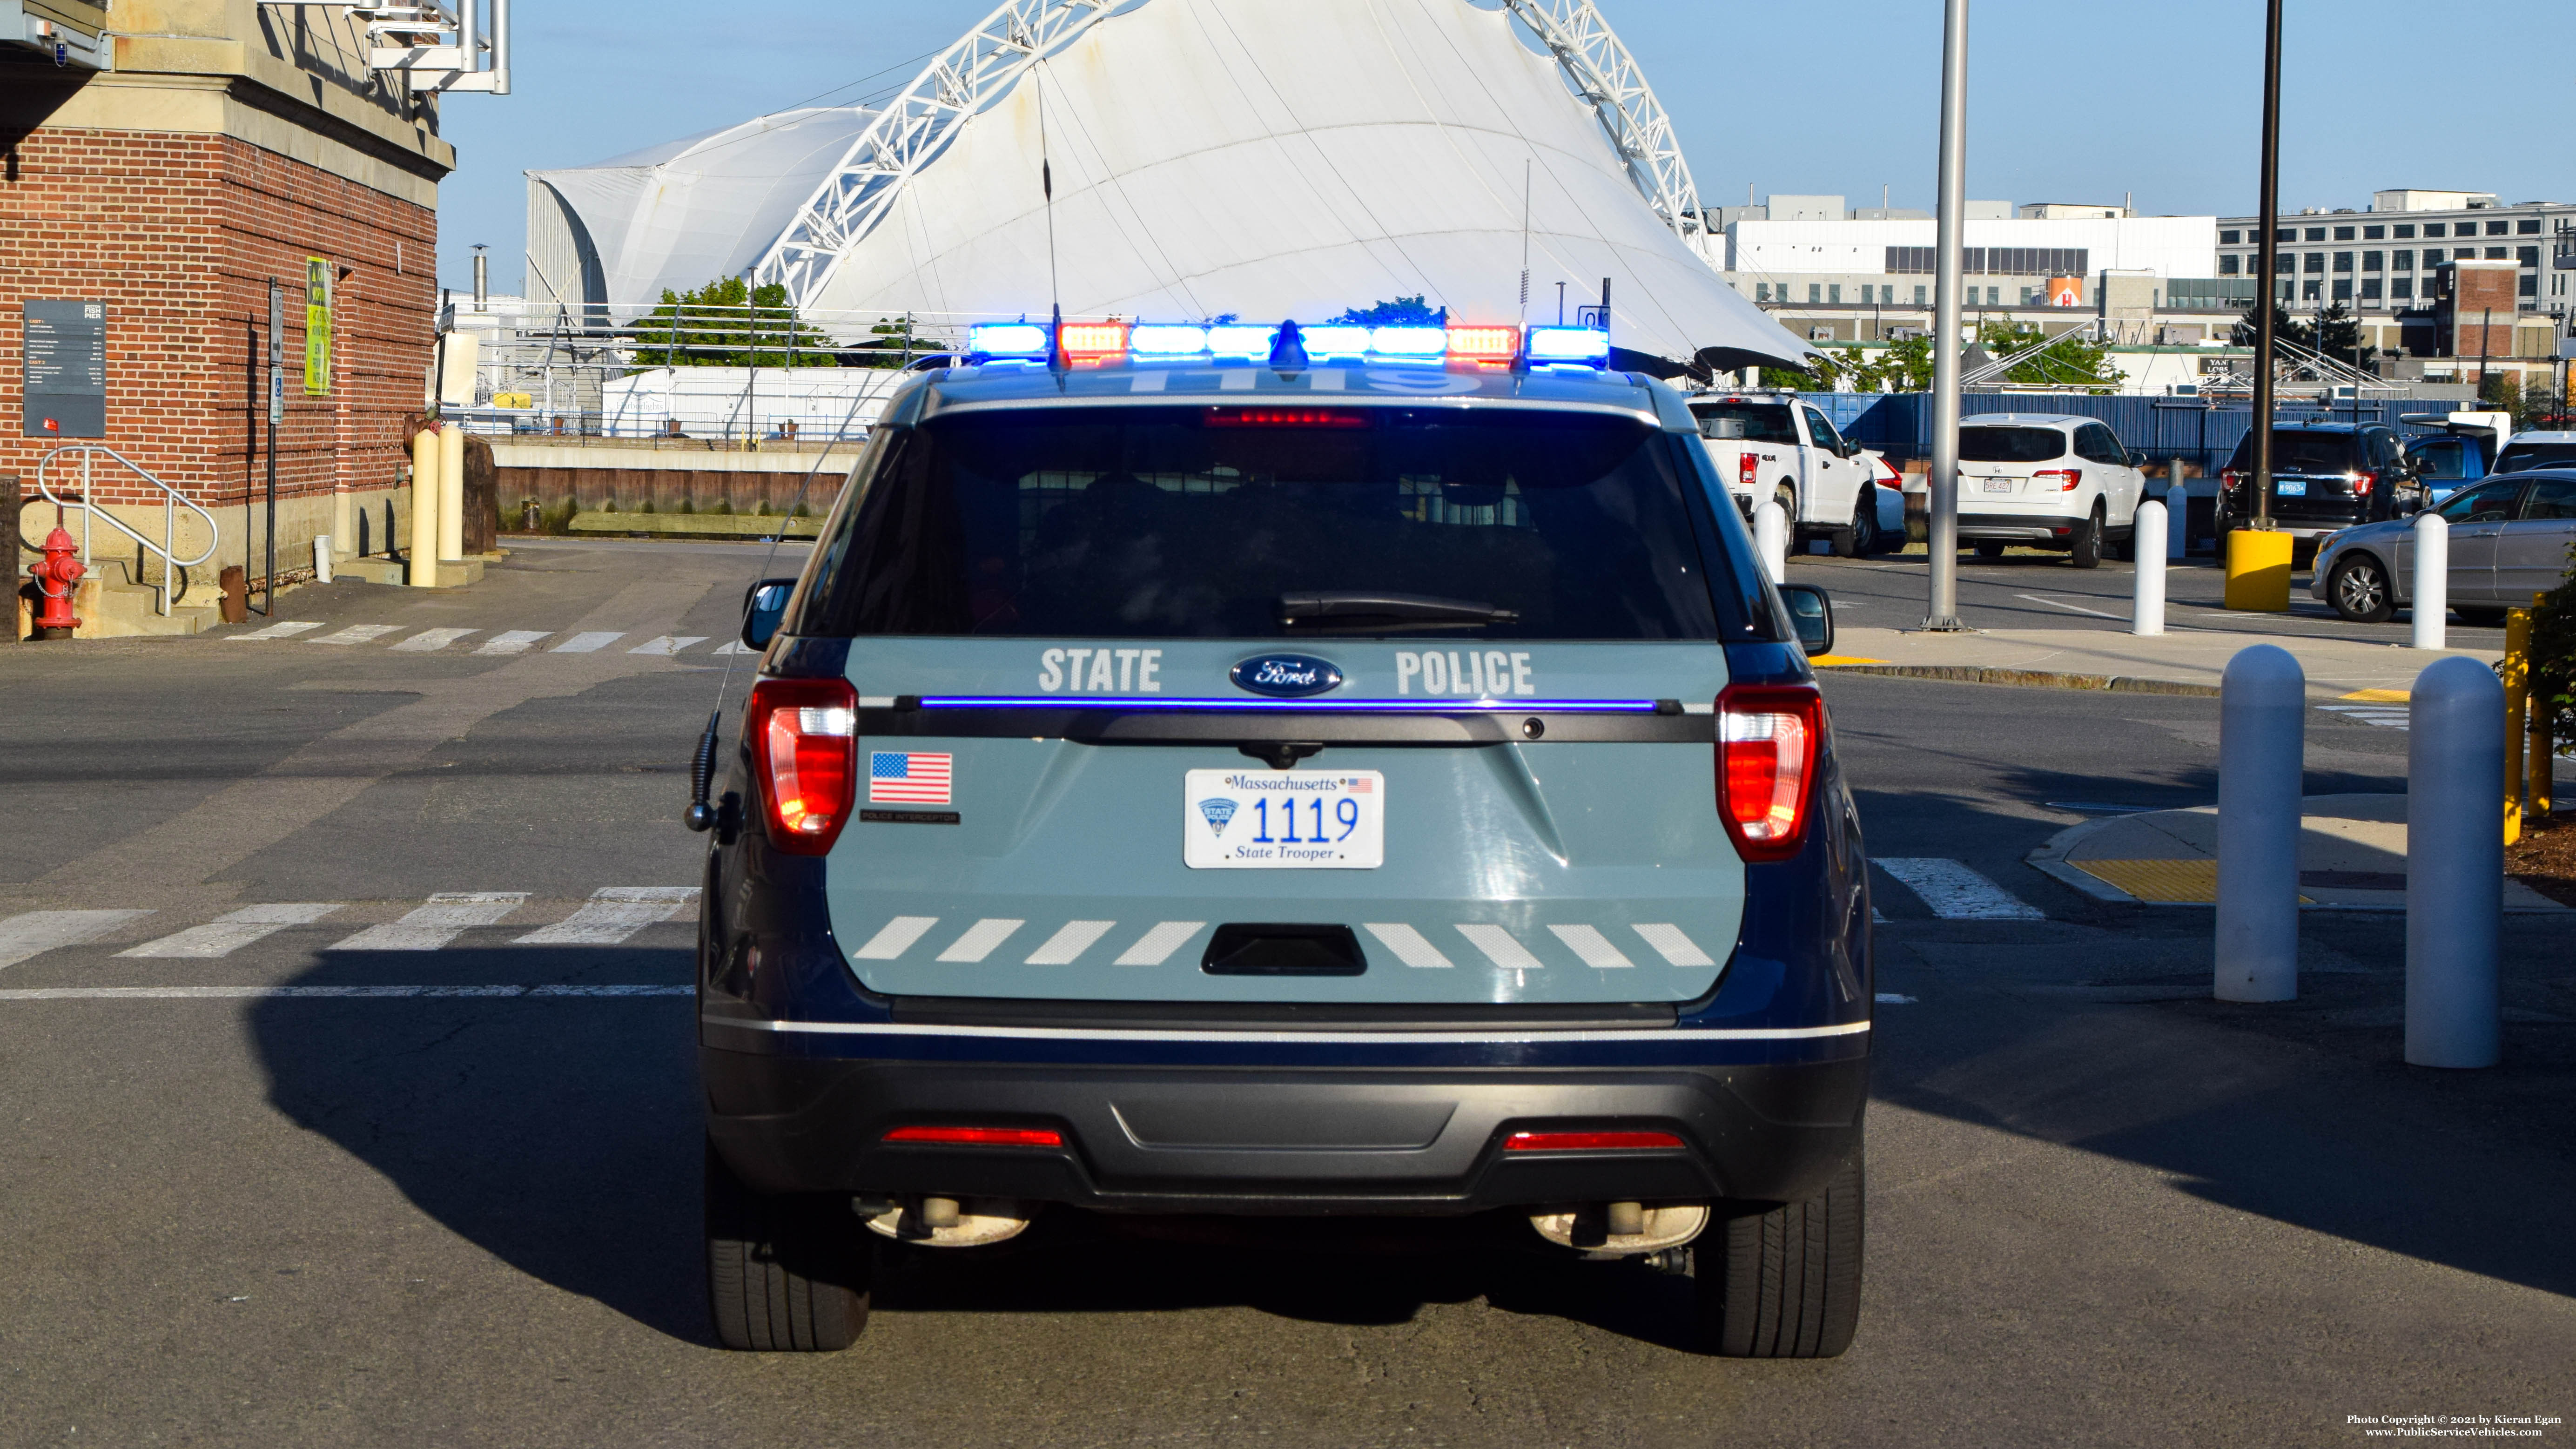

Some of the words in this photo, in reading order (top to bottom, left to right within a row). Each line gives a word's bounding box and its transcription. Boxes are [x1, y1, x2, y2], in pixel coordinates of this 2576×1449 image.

[617, 402, 663, 411] Harborlights
[1038, 648, 1163, 692] STATE
[1395, 651, 1535, 695] POLICE
[1254, 660, 1317, 685] Ford
[1231, 775, 1338, 790] Massachusetts
[862, 812, 892, 820] POLICE
[895, 813, 957, 822] INTERCEPTOR
[1252, 797, 1358, 843] 1119
[1235, 846, 1273, 858] State
[1278, 846, 1334, 862] Trooper
